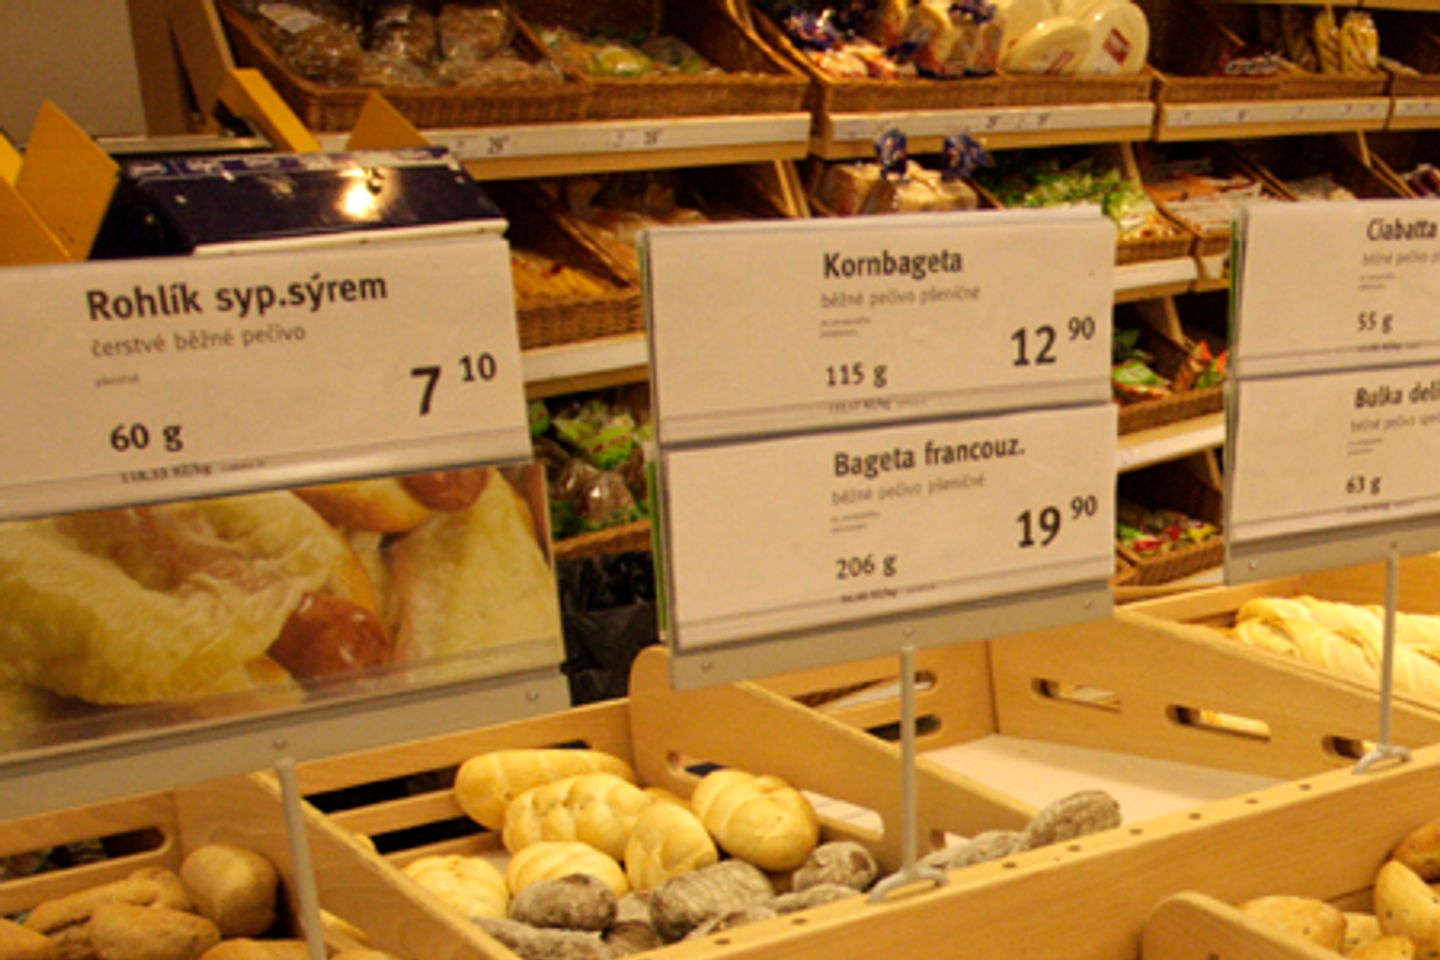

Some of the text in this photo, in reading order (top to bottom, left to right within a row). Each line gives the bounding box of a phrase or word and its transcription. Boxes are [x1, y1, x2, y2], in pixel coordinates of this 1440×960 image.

[1366, 217, 1438, 243] Ciabatta
[822, 248, 963, 280] Kornbageta
[86, 273, 389, 321] Rohlík syp.sýrem
[820, 289, 865, 310] běžné
[869, 288, 916, 310] pečivo
[1357, 311, 1393, 335] 55 g
[90, 324, 307, 359] čerstvé běžné pečivo
[1010, 316, 1095, 368] 12 90
[410, 352, 497, 416] 7 10
[825, 363, 888, 388] 115 g
[1353, 385, 1403, 409] Bulka
[109, 422, 184, 452] 60 g
[833, 437, 1026, 480] Bageta francouz.
[1370, 475, 1382, 496] g
[1015, 494, 1098, 550] 19 90
[835, 554, 898, 581] 206 g
